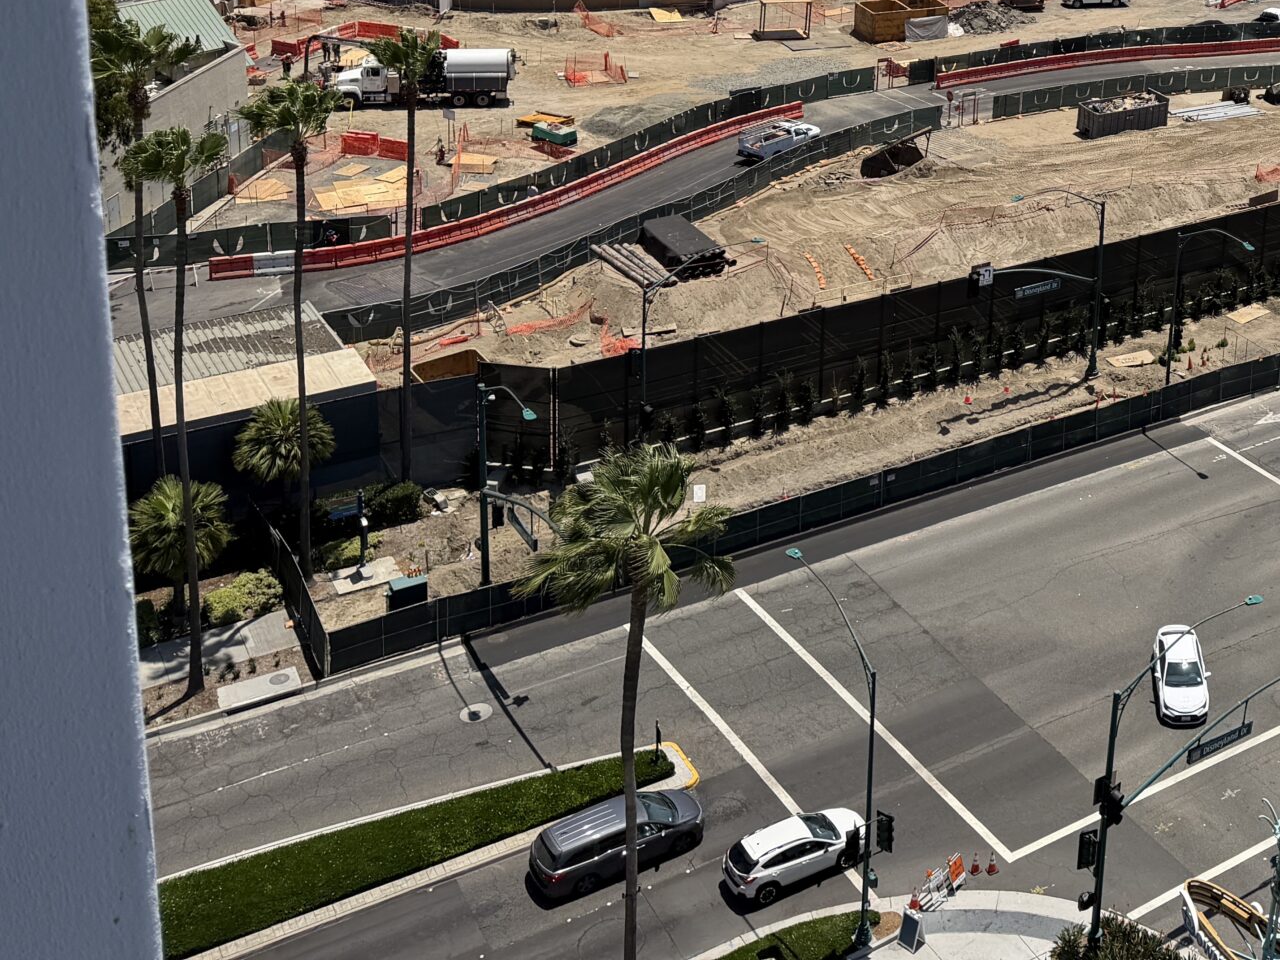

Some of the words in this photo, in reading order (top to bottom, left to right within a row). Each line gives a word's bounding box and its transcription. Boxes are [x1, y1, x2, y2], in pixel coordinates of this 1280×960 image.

[1024, 284, 1051, 296] Disneyland
[1202, 730, 1239, 755] Disneyland
[1240, 726, 1248, 735] Dr
